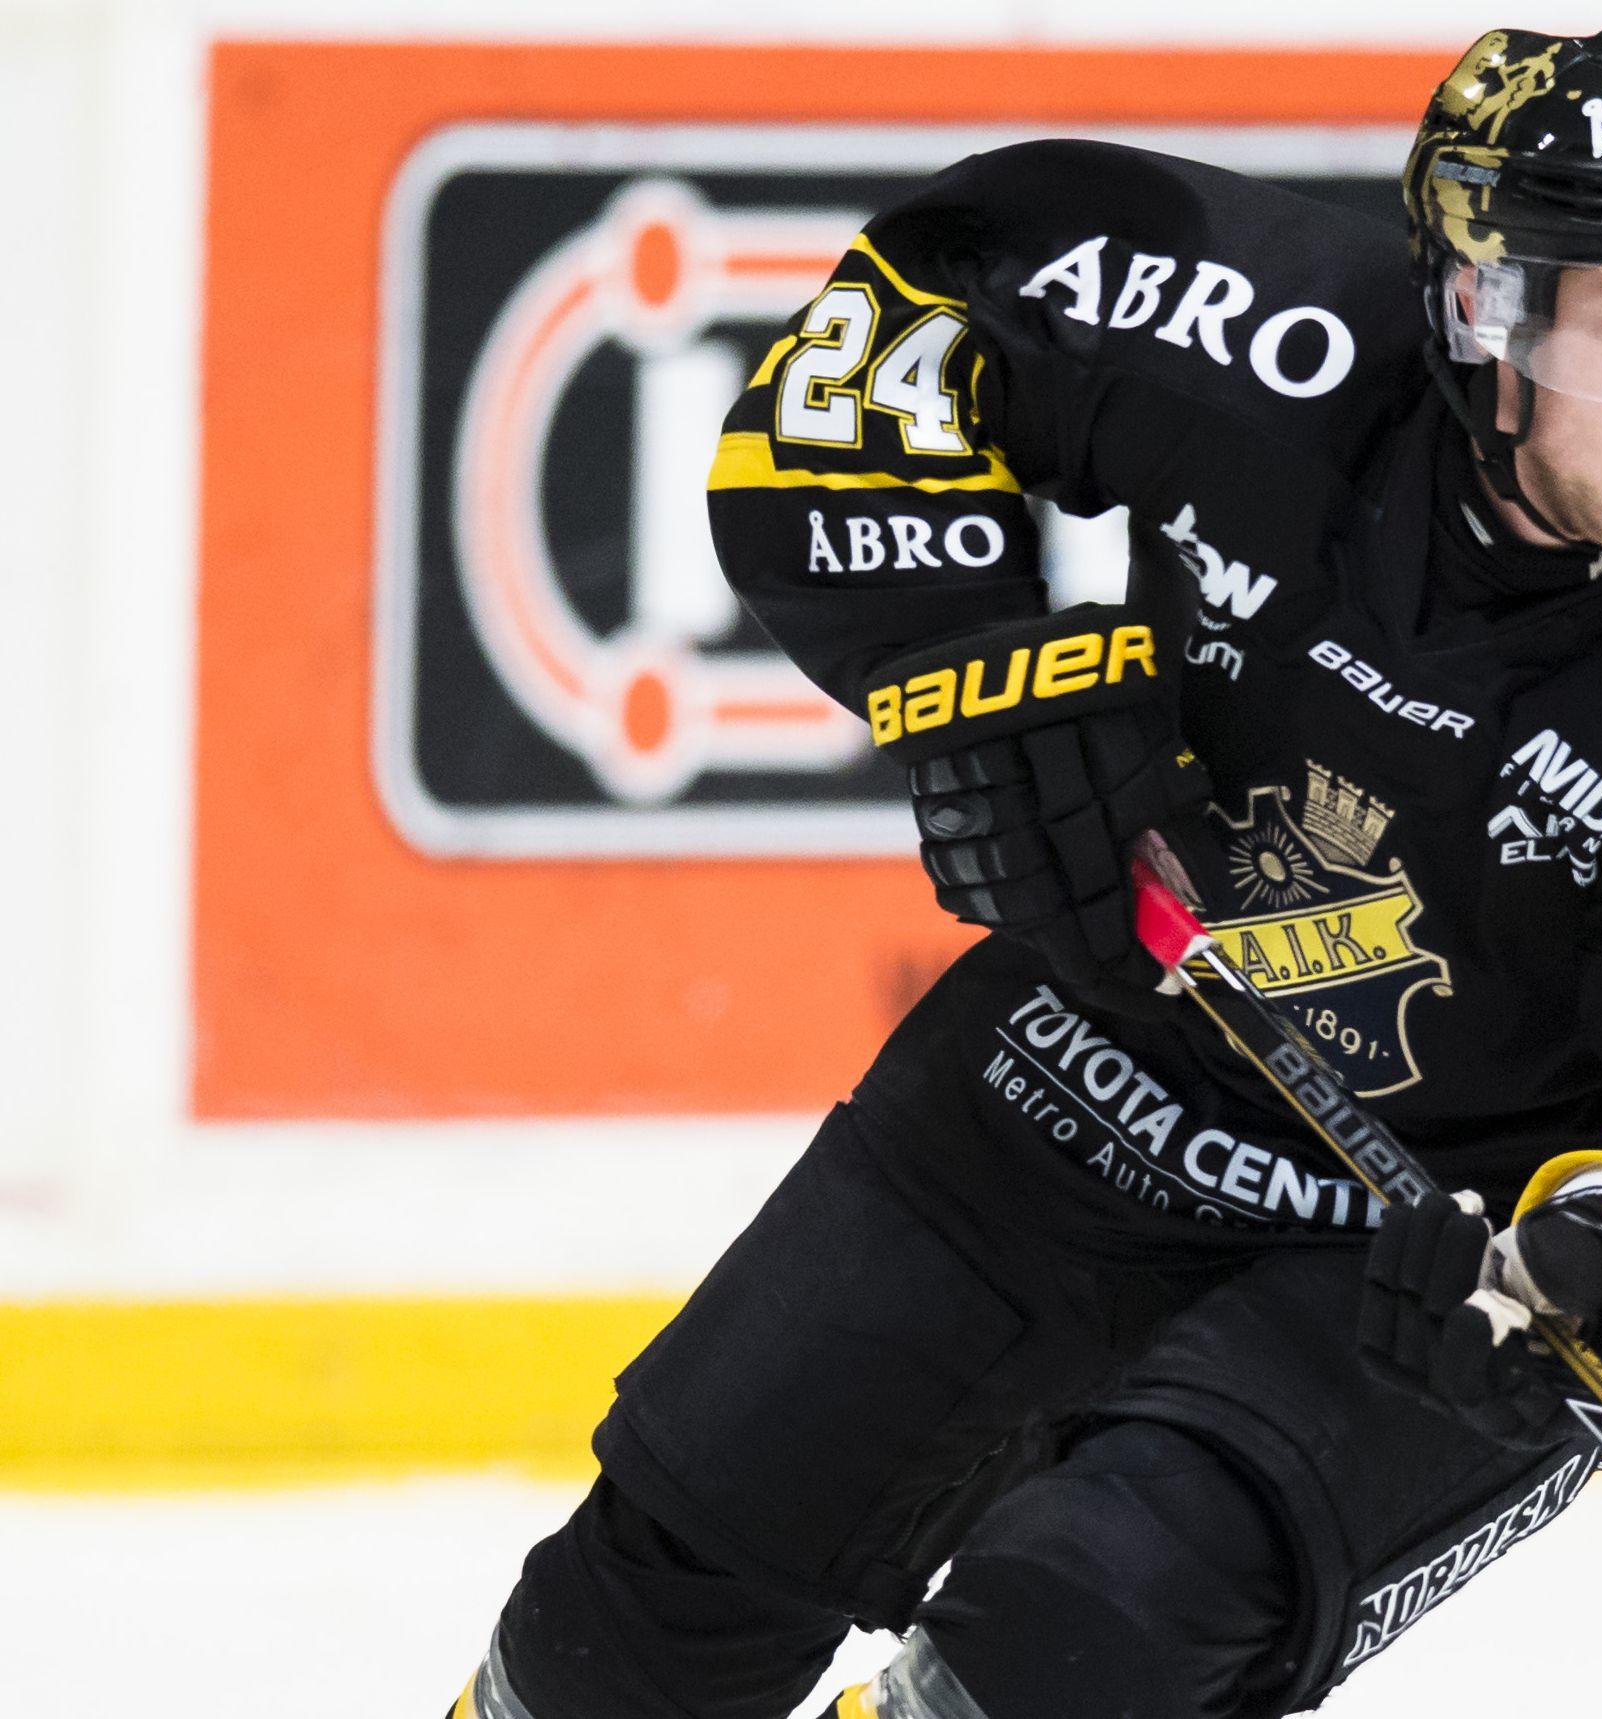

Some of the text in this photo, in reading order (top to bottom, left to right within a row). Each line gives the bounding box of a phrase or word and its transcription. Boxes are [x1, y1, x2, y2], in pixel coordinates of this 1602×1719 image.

[776, 281, 973, 456] 24
[807, 509, 1005, 573] ÅBRO
[983, 1049, 1079, 1142] Metro
[1007, 984, 1184, 1157] TOYOTA
